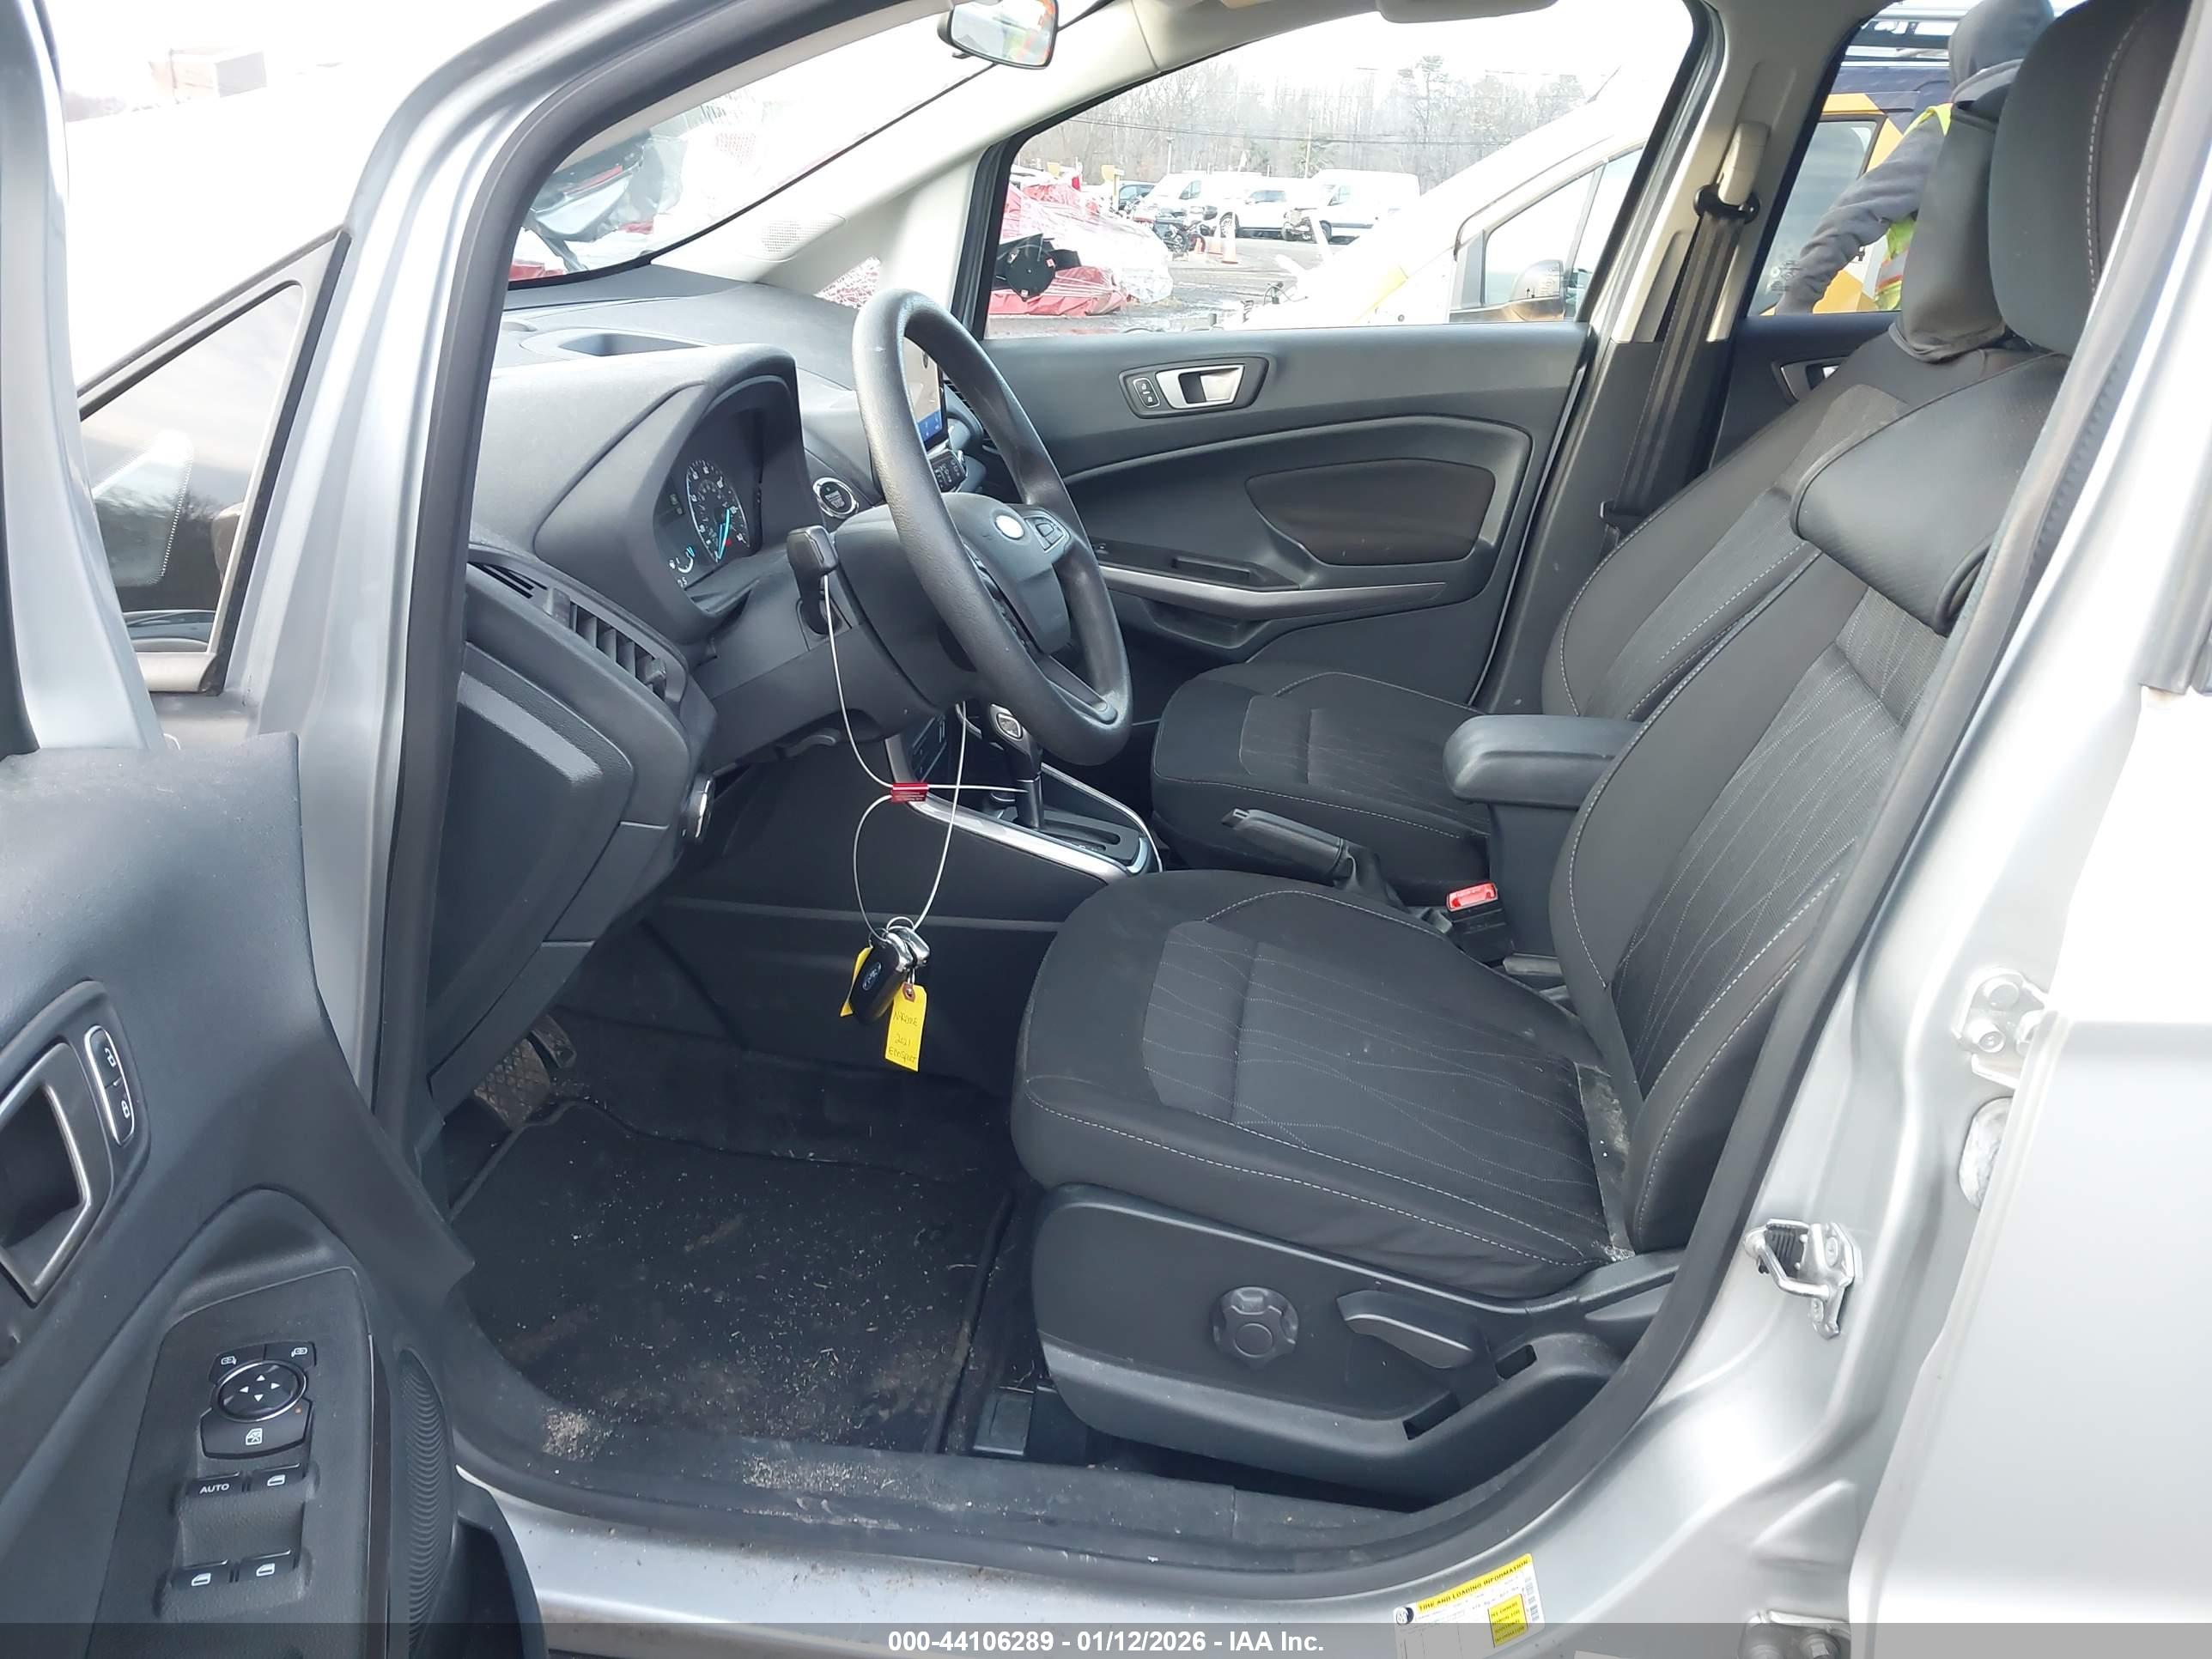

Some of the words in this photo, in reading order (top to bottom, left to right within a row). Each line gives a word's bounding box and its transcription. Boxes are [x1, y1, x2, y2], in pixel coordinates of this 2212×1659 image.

[199, 1483, 230, 1494] AUTO
[1437, 1595, 1451, 1606] AND
[1452, 1583, 1482, 1600] LOADING
[1483, 1559, 1528, 1586] INFORMATION
